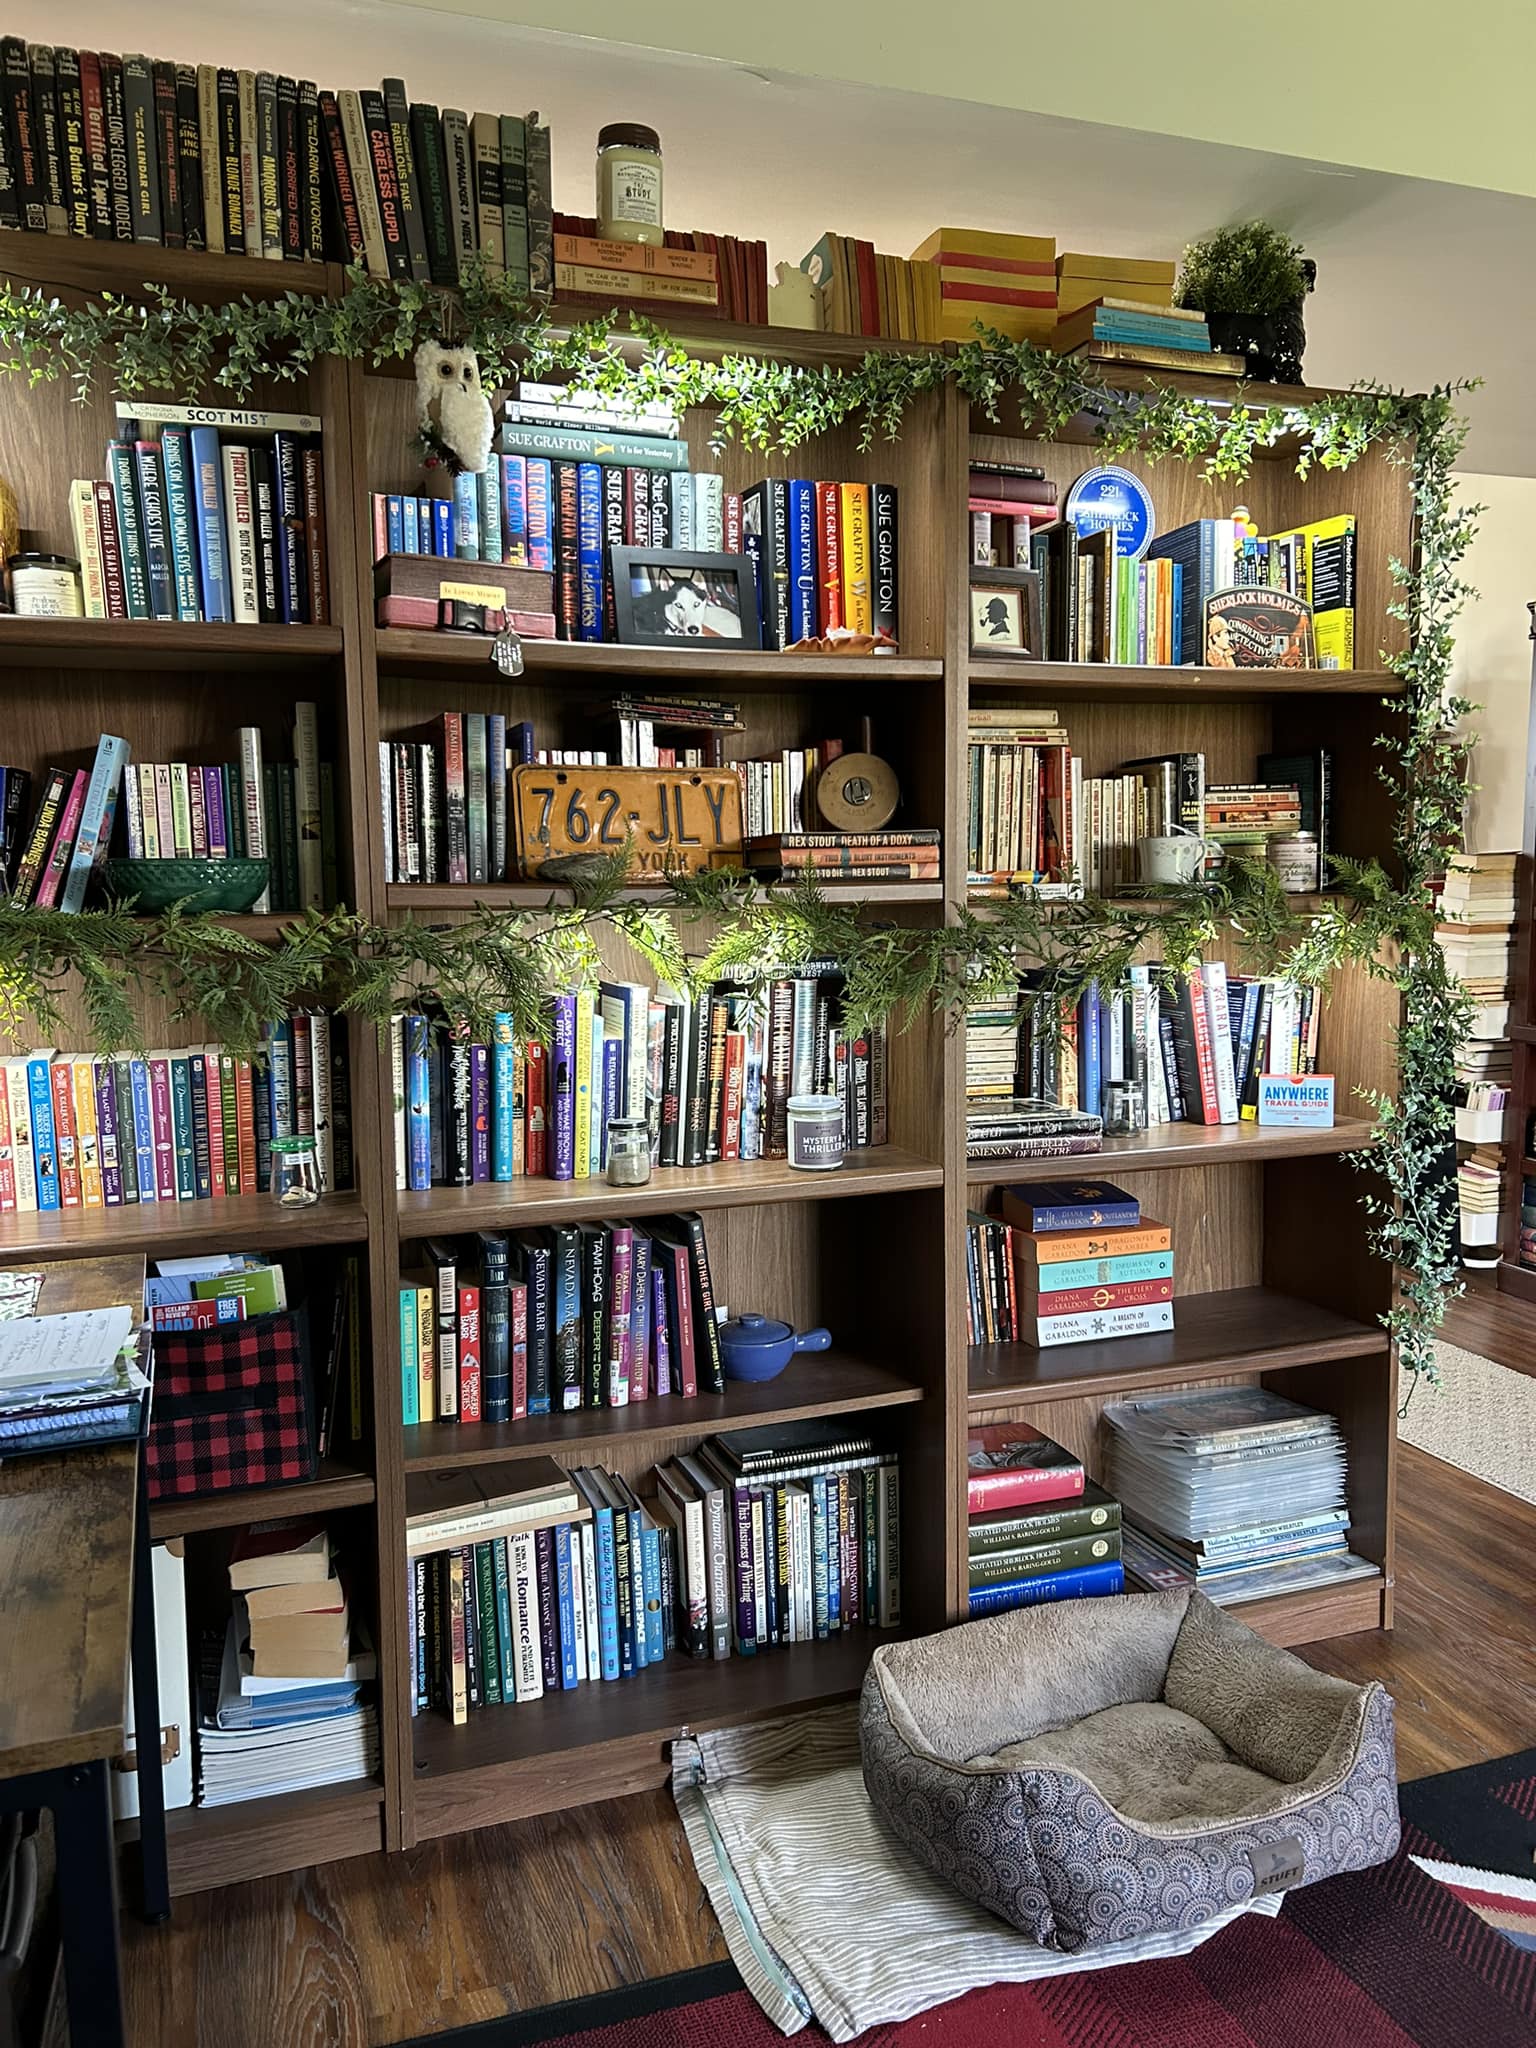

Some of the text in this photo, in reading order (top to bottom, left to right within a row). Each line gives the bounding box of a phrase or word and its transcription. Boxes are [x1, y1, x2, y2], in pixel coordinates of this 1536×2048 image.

[88, 106, 107, 172] Terrified
[66, 120, 89, 235] Sun Diary
[110, 117, 131, 239] LONG-LEGGED MODELS
[135, 131, 150, 216] CALENDAR GIRL
[332, 149, 352, 202] WORRIED
[390, 123, 412, 212] FABULOUS FAKE
[226, 156, 241, 235] BLONDE BONANZA
[262, 155, 279, 237] AMOROUS AUNT
[287, 152, 300, 246] HORRIFIED HEIRS
[307, 136, 323, 251] DARING DIVORCEE
[371, 130, 400, 242] CARELESS CUPID
[461, 219, 473, 250] NIECE
[187, 409, 226, 422] SCOT
[231, 413, 268, 426] MIST
[508, 432, 592, 453] SUE GRAFTON
[142, 455, 165, 549] WHERE ECHOES LIVE
[284, 479, 297, 516] MULLER
[507, 460, 524, 535] SUE GRAFTON
[527, 463, 546, 538] SUE GRAFTON
[606, 470, 622, 501] SUE
[634, 472, 648, 502] SUE
[652, 475, 669, 502] Sue
[774, 484, 785, 508] SUE
[234, 488, 250, 523] MULLER
[728, 495, 738, 519] SUE
[172, 492, 192, 574] DEAD EYES
[775, 508, 786, 567] GRAFTON
[799, 489, 811, 571] SUE GRAFTON
[826, 490, 838, 574] SUE GRAFTON
[852, 492, 865, 575] SUE GRAFTON
[878, 493, 893, 612] SUE GRAFTON
[1344, 535, 1354, 607] Sherlock Holmes
[778, 593, 787, 607] for
[1208, 591, 1302, 616] SHERLOCK HOLMES
[25, 800, 58, 867] LINDA BARNES
[788, 833, 913, 847] REX STOUT DOXY
[867, 867, 889, 876] STOUT
[774, 988, 791, 1028] PATRICIA
[817, 1002, 828, 1037] PATRICIA
[1134, 988, 1146, 1049] DARKNESS
[607, 1056, 616, 1072] RITA
[1194, 995, 1217, 1110] TOO BREATHE
[727, 1067, 741, 1087] Body
[873, 1062, 881, 1102] CORNWELL
[1265, 1085, 1329, 1101] ANYWHERE
[102, 1098, 111, 1113] LAST
[1264, 1099, 1329, 1108] TRAVEL GUIDE
[194, 1117, 207, 1167] ON DEMAND
[562, 1132, 570, 1160] BROWN
[579, 1147, 587, 1164] NAP
[802, 1135, 837, 1145] MYSTERY
[966, 1145, 1012, 1157] SIMENON
[1019, 1140, 1041, 1150] THE
[48, 1179, 56, 1203] ELLERY
[536, 1253, 546, 1331] NEVADA BARR
[614, 1272, 622, 1311] CHAPTER
[635, 1246, 646, 1303] MARY DAHEIM
[694, 1237, 712, 1312] THE OTHER GIRL
[165, 1304, 190, 1313] ICELAND
[217, 1299, 238, 1311] FREE
[218, 1310, 238, 1321] COPY
[564, 1248, 577, 1383] NEVADA BARR BURN
[593, 1237, 603, 1388] TAMI HOAG DEEPER DEAD
[1054, 1293, 1080, 1304] DIANA
[155, 1318, 195, 1332] MAP
[460, 1315, 470, 1340] BARR
[469, 1309, 479, 1343] NEVADA
[1044, 1328, 1088, 1341] GABALDON
[1052, 1319, 1079, 1330] DIANA
[614, 1513, 628, 1543] WRITING
[840, 1507, 849, 1532] DEATH
[1016, 1526, 1061, 1538] BARING-GOULD
[1259, 1521, 1304, 1535] DENNIS WHEATLEY
[1292, 1528, 1318, 1538] WHEATLEY
[709, 1498, 727, 1614] Dynamic Characters
[737, 1499, 754, 1603] This Business Writing
[1018, 1557, 1061, 1570] BARING-GOULD
[416, 1562, 426, 1593] Writing
[559, 1561, 572, 1592] PERSONS
[848, 1540, 858, 1602] HEMINGWAY
[632, 1539, 646, 1644] INSIDE OUTER SPACE
[814, 1561, 829, 1627] MYSTERY WRITING
[481, 1556, 498, 1670] WORKING ON NEW PLAY
[515, 1576, 531, 1644] Romance
[1260, 1866, 1299, 1888] STUFT
